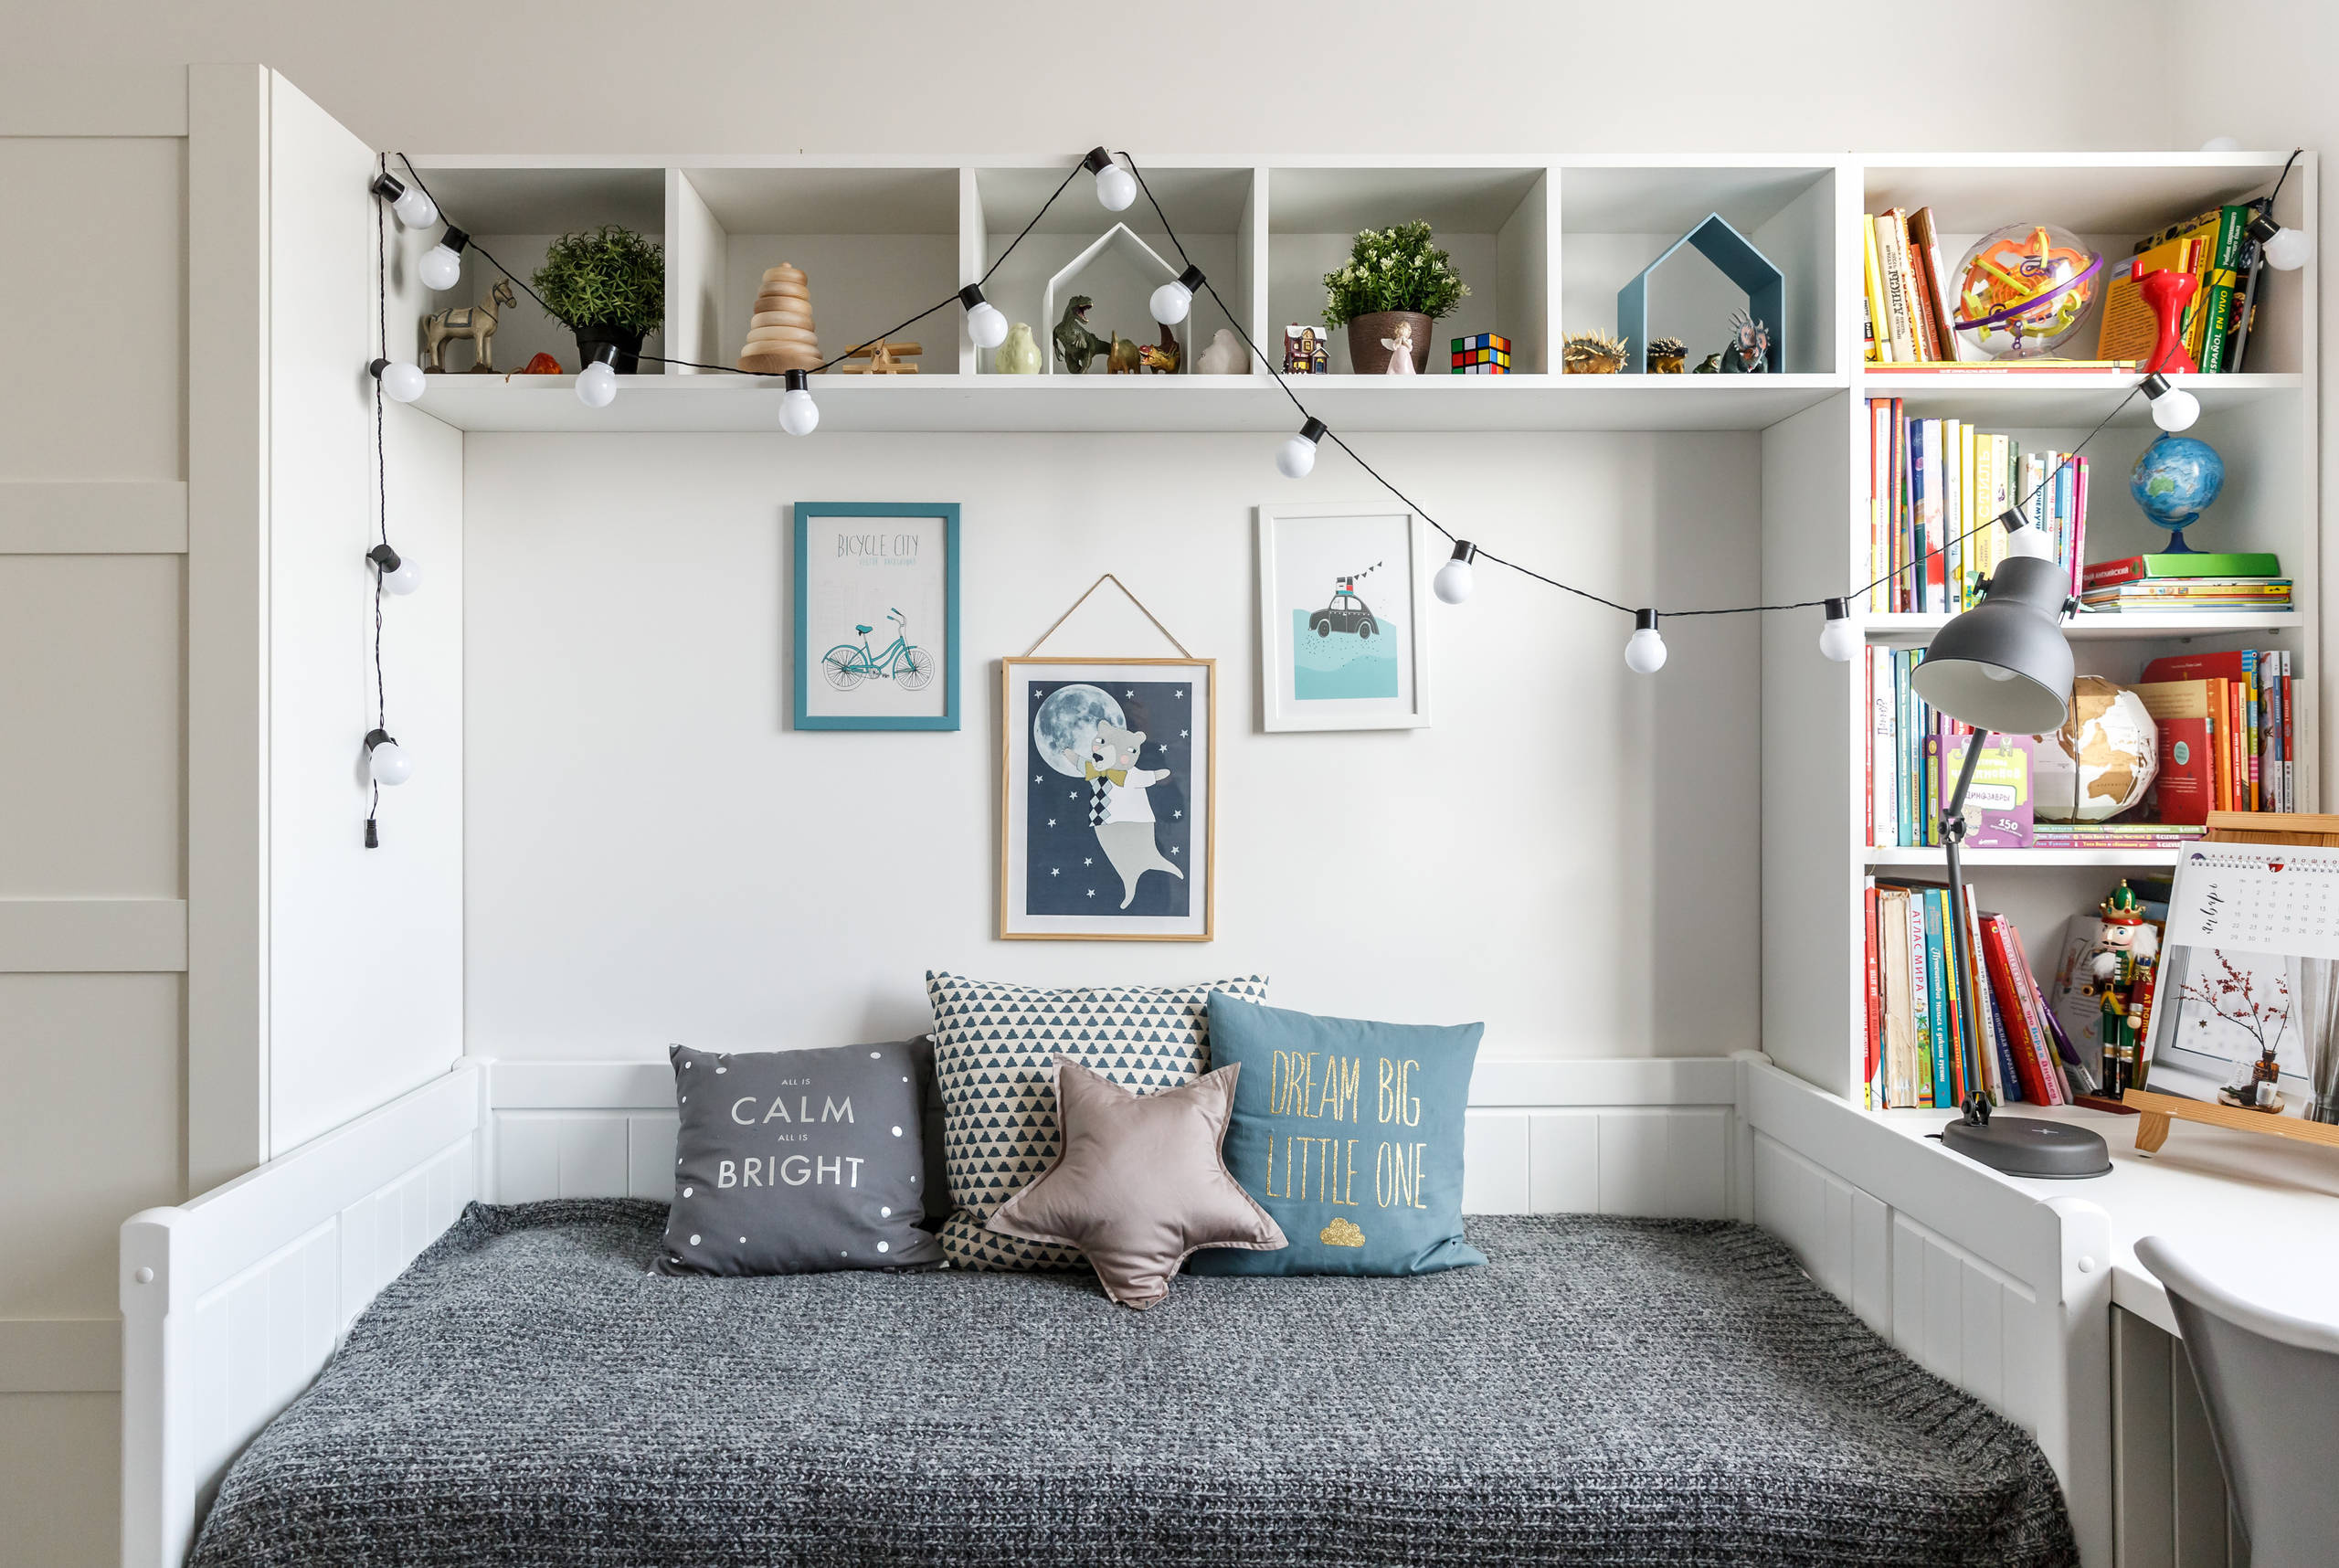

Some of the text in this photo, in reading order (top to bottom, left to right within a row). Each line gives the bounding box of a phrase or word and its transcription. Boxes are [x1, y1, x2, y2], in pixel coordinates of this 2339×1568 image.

[1888, 270, 1905, 315] АЛИСЫ
[2209, 291, 2228, 373] ESPAÑOL EN VIVO
[1978, 450, 1991, 518] СТИЛЬ
[838, 534, 918, 557] BICYCLE CITY
[1998, 818, 2017, 831] 150
[1912, 910, 1925, 991] АТЛАС МИРА
[1930, 947, 1943, 1000] Путешествие
[2143, 993, 2151, 1008] At
[1935, 1033, 1945, 1057] дикими
[1994, 1012, 2017, 1084] СНЕЖНАЯ КОРОЛЕВА
[2026, 1011, 2035, 1025] про
[2031, 1027, 2043, 1052] Веру
[2041, 1060, 2058, 1099] Анфису
[1270, 1050, 1421, 1127] DREAM BIG
[1937, 1059, 1946, 1082] гусями
[732, 1096, 855, 1126] CALM
[778, 1133, 809, 1141] ALL IS
[718, 1155, 864, 1191] BRIGHT
[1266, 1135, 1426, 1209] LITTLE ONE
